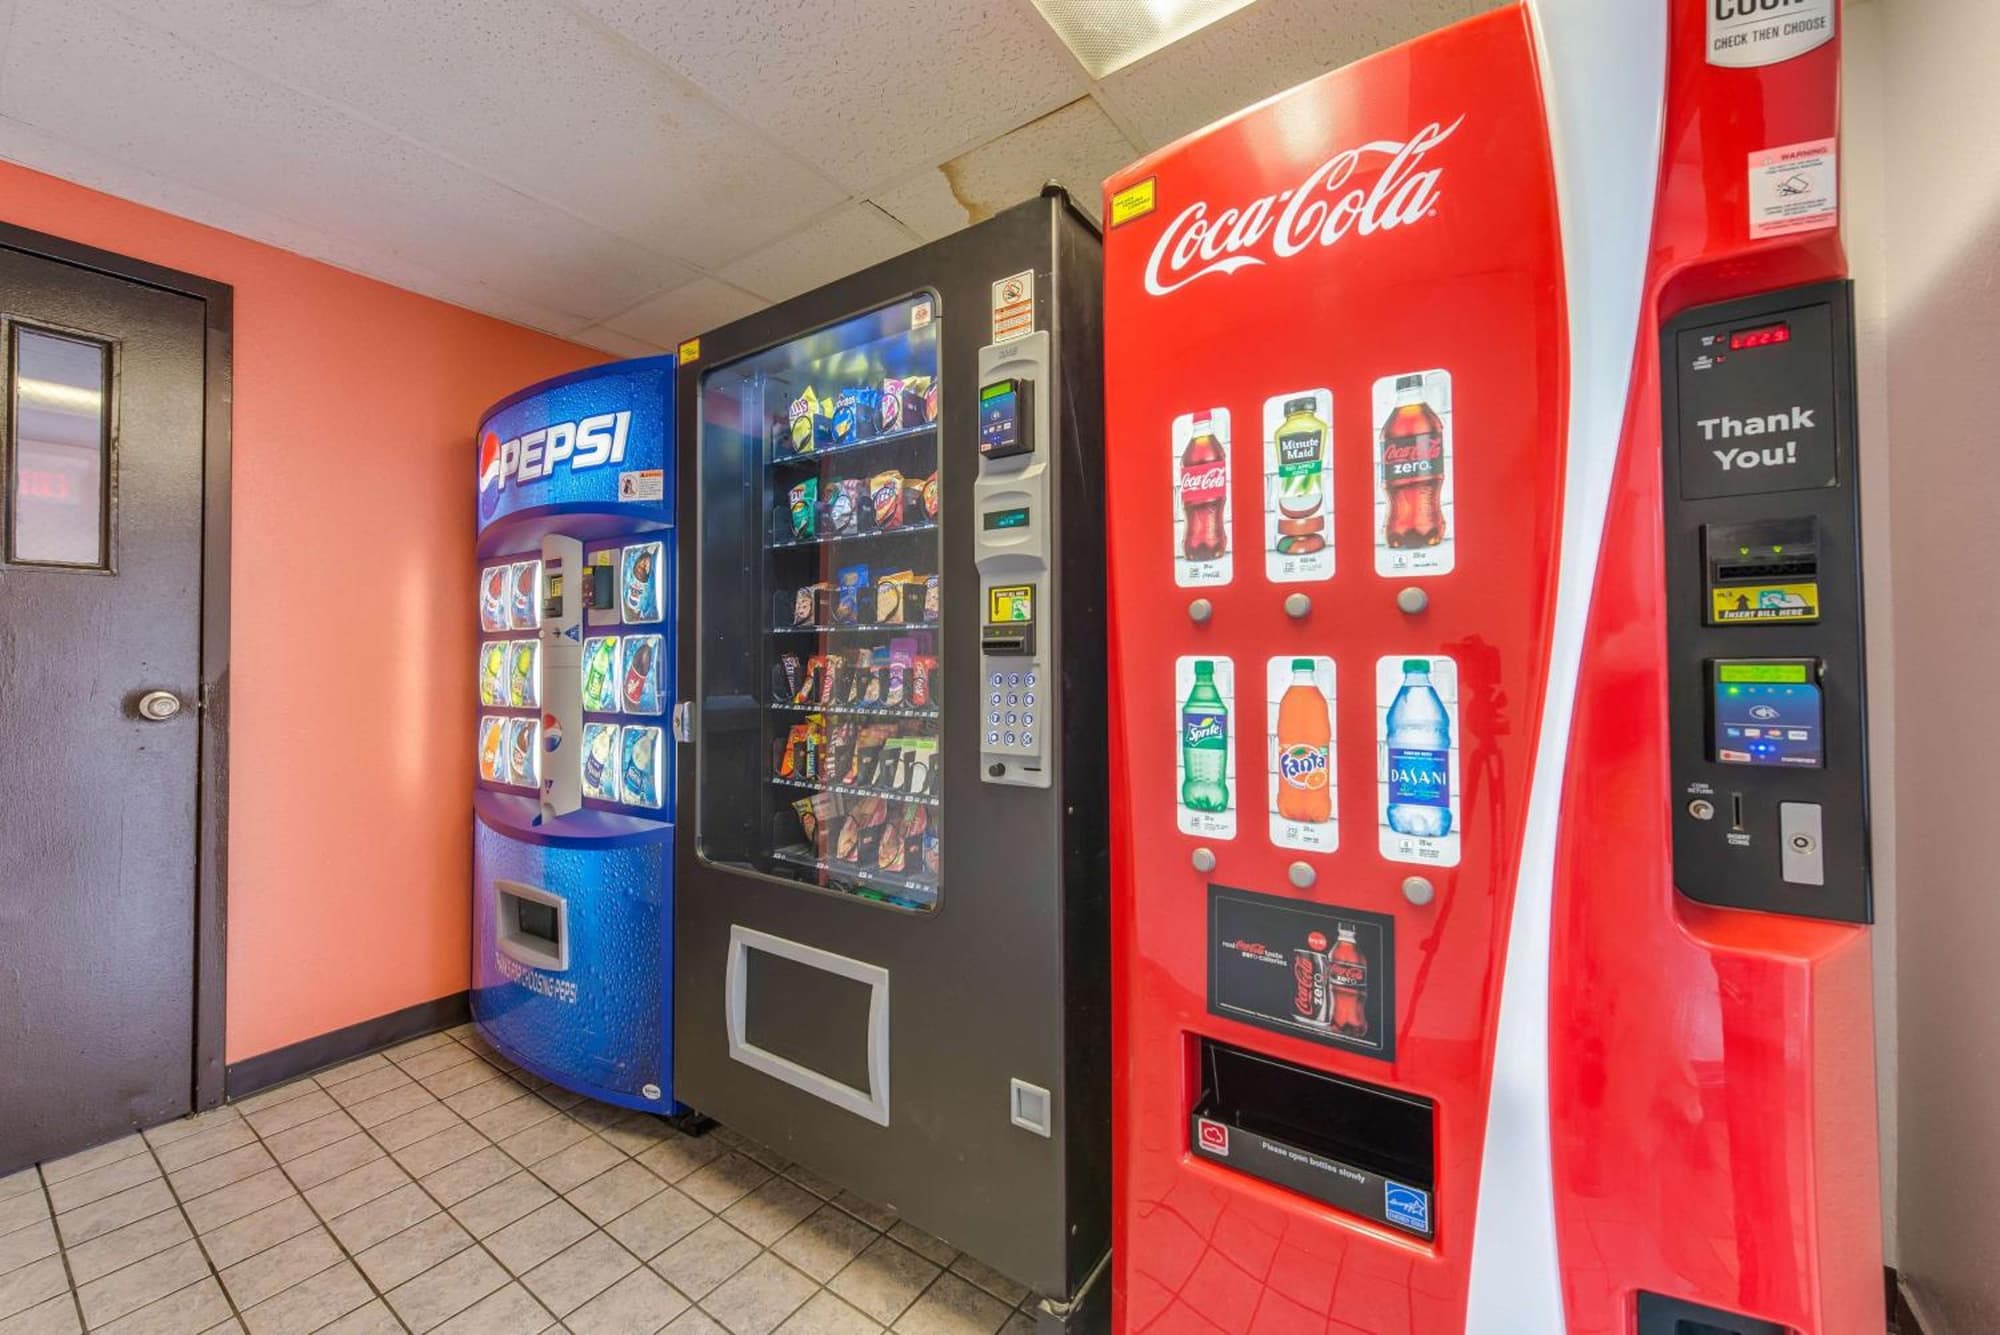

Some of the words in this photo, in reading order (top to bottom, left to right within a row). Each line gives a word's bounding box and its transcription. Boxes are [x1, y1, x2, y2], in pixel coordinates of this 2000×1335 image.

[1713, 33, 1749, 51] CHECK
[1753, 26, 1779, 42] THEN
[1783, 16, 1827, 36] CHOOSE
[1781, 146, 1828, 161] WARNING
[1144, 112, 1466, 296] Coca-Cola
[1697, 406, 1816, 441] Thank
[498, 411, 631, 489] PEPSI
[1282, 438, 1319, 451] Minute
[1287, 447, 1314, 460] Maid
[1383, 439, 1441, 465] Coca-Cola
[1713, 442, 1797, 471] You!
[1180, 466, 1226, 493] Coca-Cola
[1393, 461, 1430, 475] zero
[1723, 608, 1755, 619] INSERT
[1189, 723, 1221, 742] Sprite
[1391, 767, 1447, 786] DASANI
[1294, 959, 1313, 1015] Coca-Cola
[1313, 973, 1323, 1006] zero
[1262, 1141, 1287, 1156] Please
[1288, 1150, 1308, 1164] open
[1309, 1157, 1337, 1173] bottles
[1338, 1168, 1366, 1184] slowly
